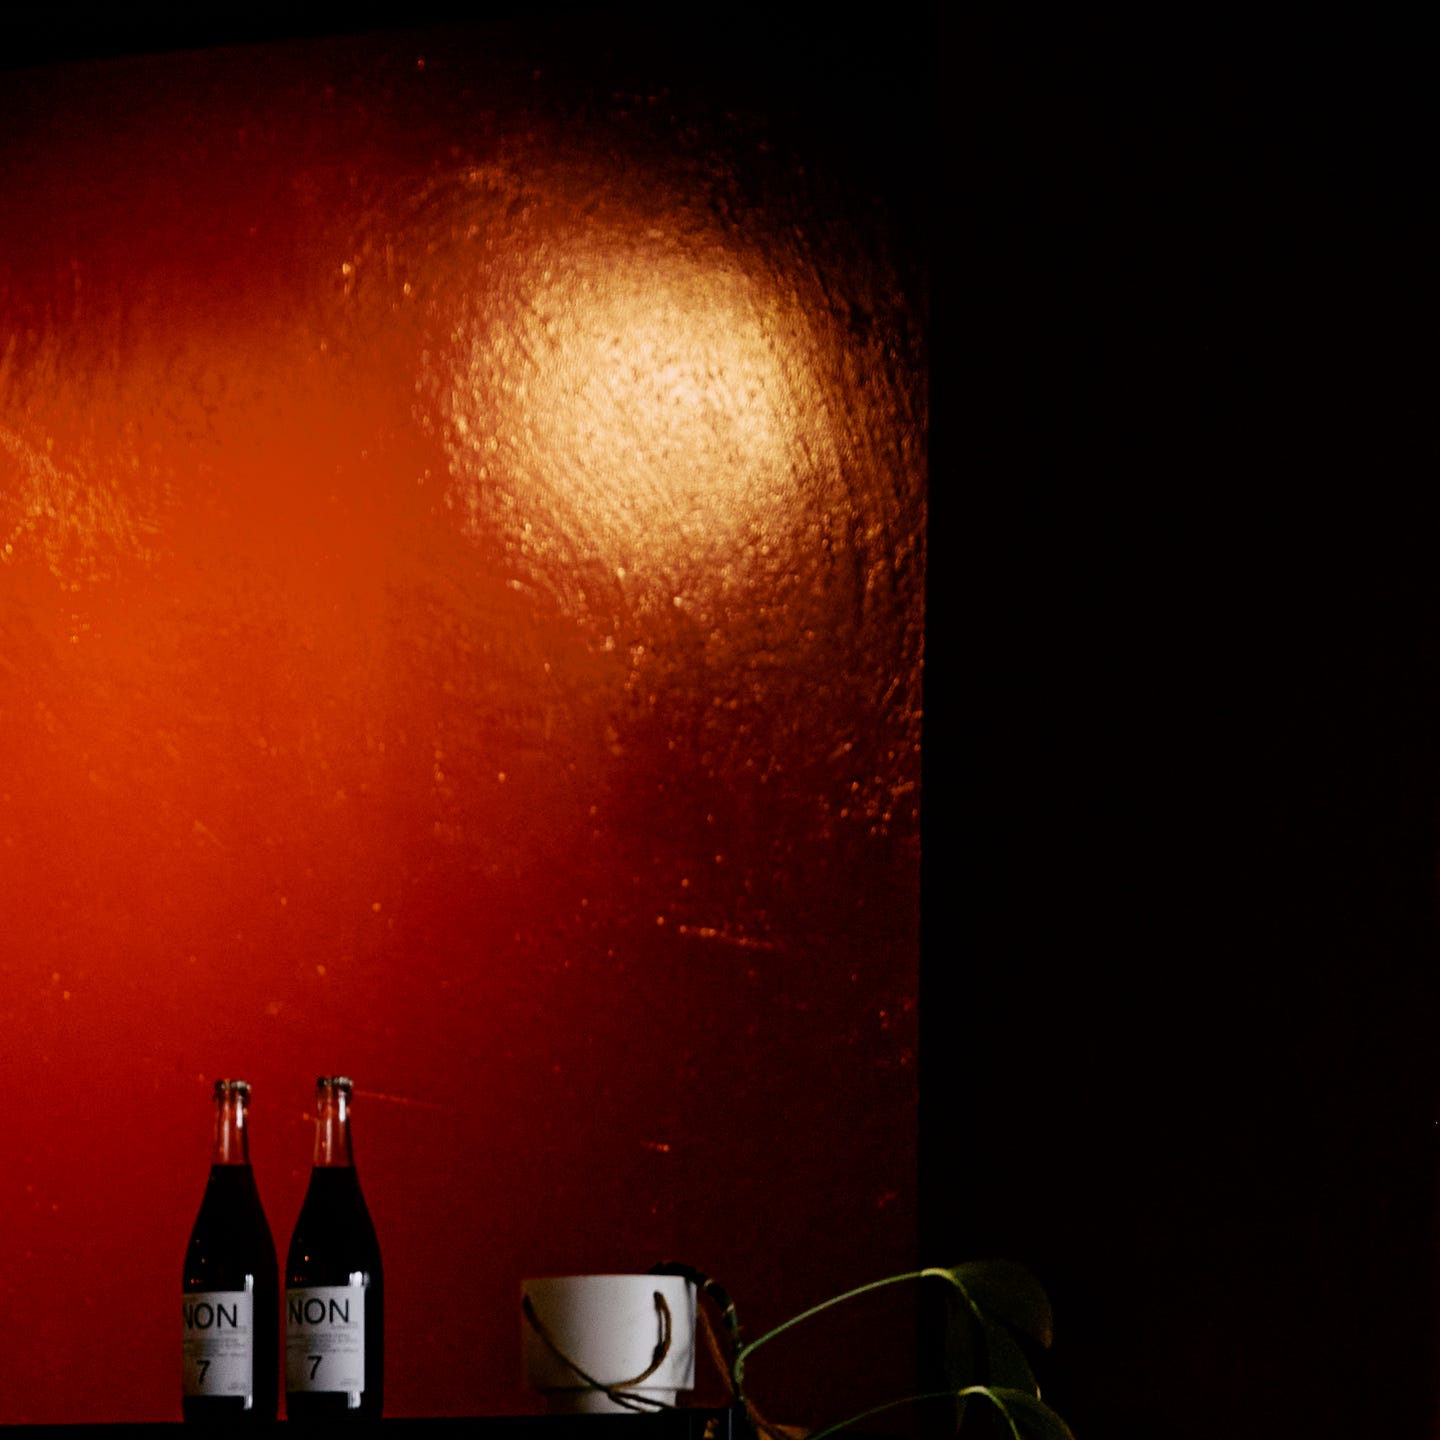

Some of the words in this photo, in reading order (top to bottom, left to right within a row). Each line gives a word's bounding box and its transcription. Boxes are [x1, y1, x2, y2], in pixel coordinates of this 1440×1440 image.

[183, 1303, 237, 1328] NON
[289, 1299, 349, 1325] NON
[197, 1360, 211, 1384] 7
[308, 1355, 322, 1380] 7
